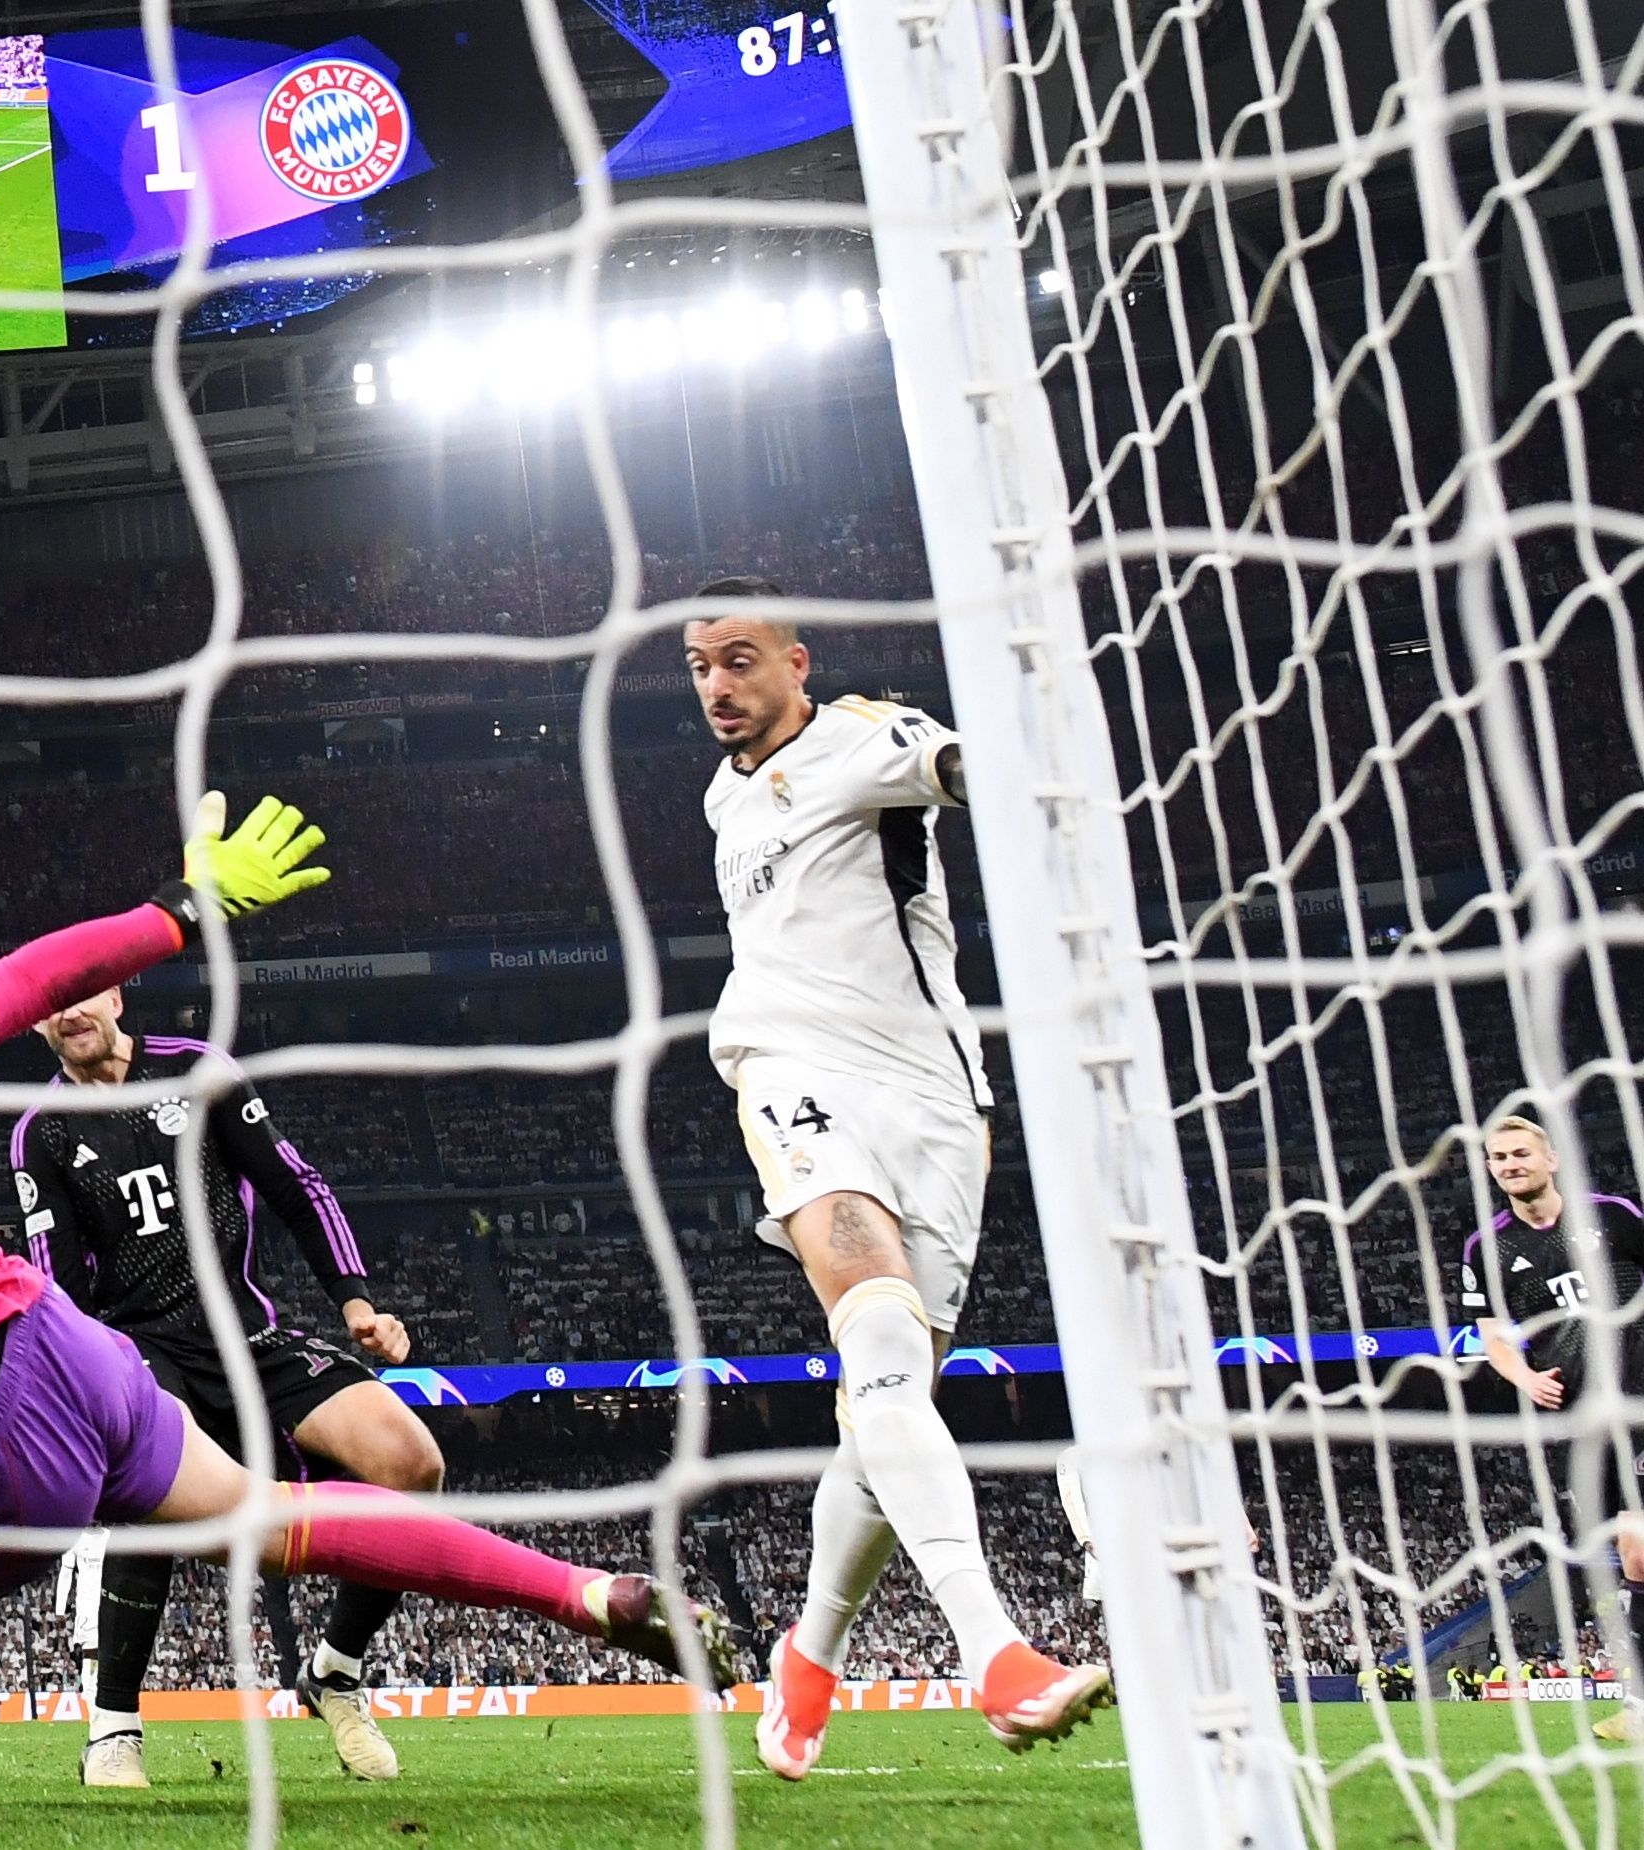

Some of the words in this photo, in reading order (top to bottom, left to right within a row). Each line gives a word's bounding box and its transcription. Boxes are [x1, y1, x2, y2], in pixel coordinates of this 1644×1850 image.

[737, 0, 839, 76] 87:
[270, 90, 298, 125] FC
[295, 67, 396, 117] BAYERN
[141, 101, 197, 193] 1
[274, 139, 398, 194] MÜNCHEN
[256, 967, 298, 983] Real
[305, 962, 374, 981] Madrid
[489, 951, 534, 968] Real
[539, 946, 608, 965] Madrid
[447, 1686, 538, 1716] EAT
